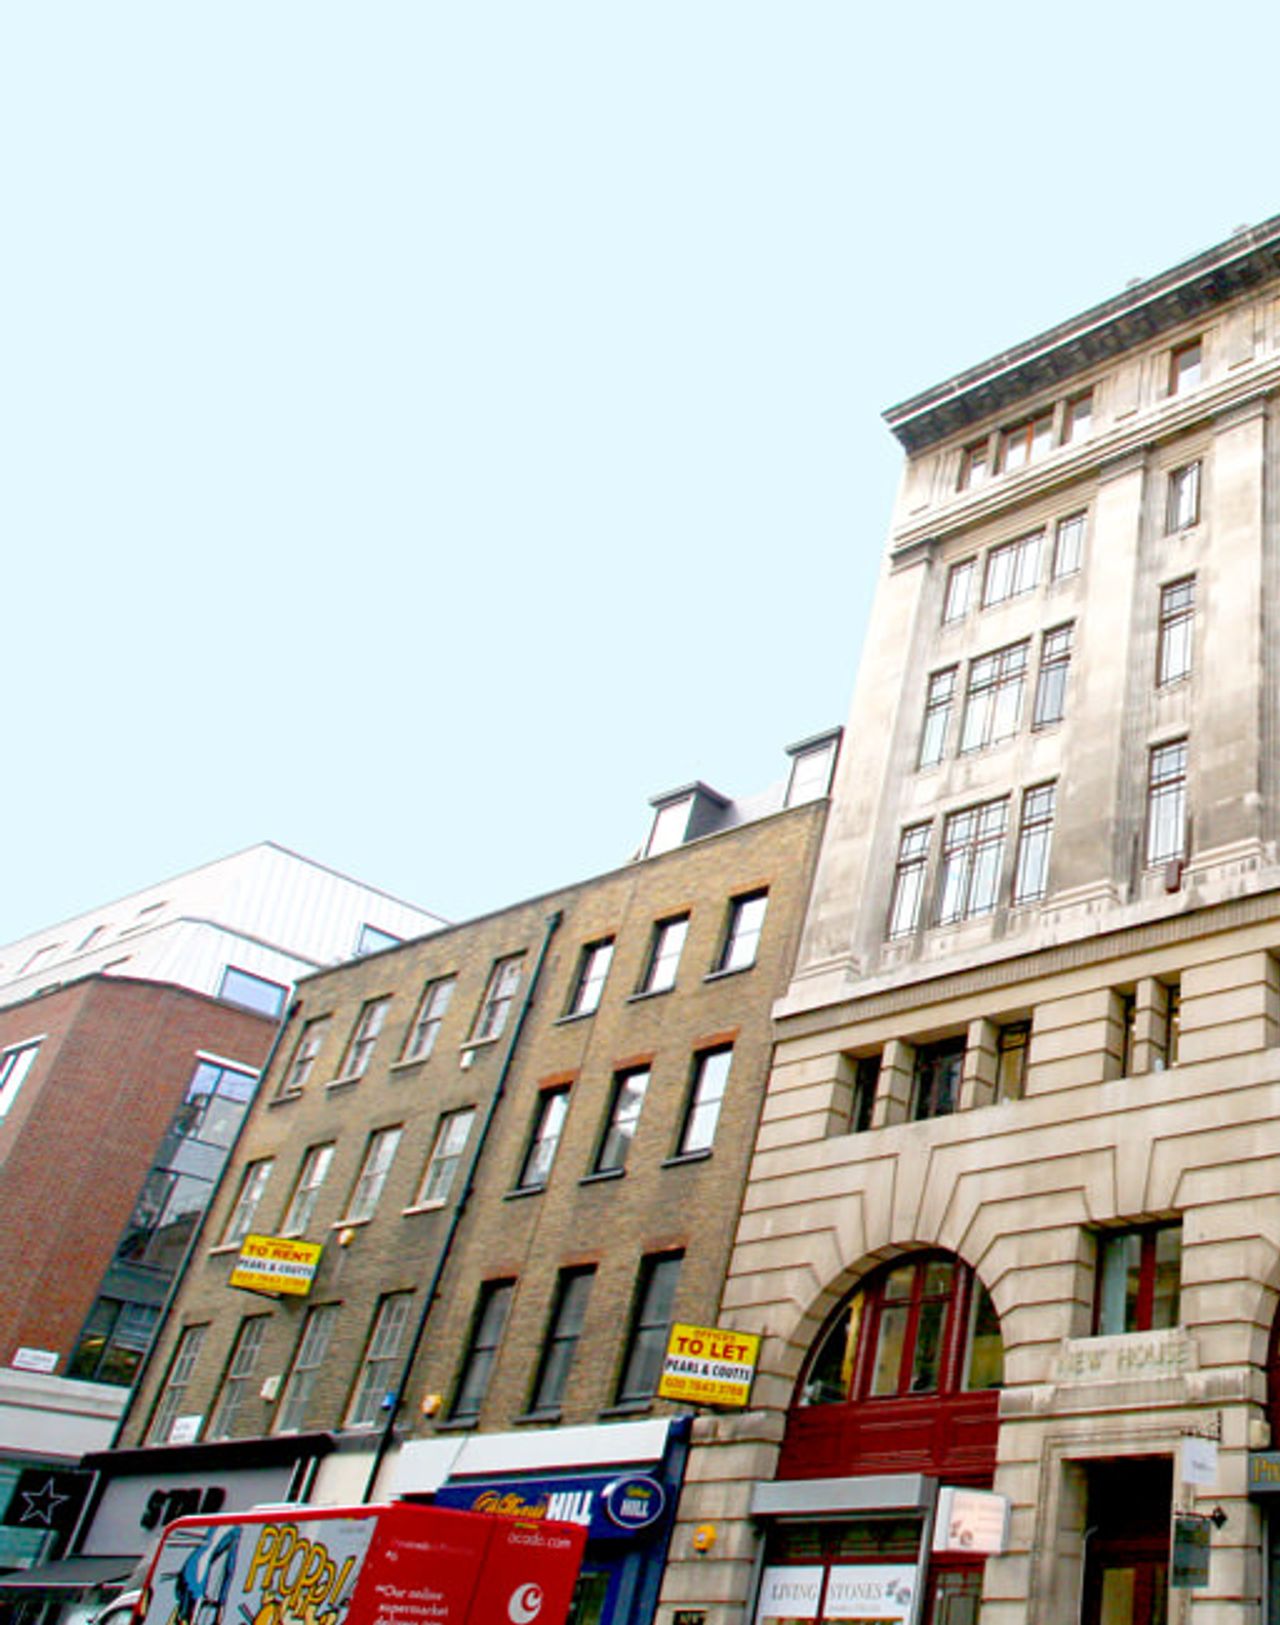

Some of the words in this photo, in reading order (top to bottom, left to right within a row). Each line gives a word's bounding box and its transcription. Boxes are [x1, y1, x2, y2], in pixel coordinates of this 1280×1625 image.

[249, 1243, 268, 1257] TO
[273, 1247, 314, 1263] RENT
[678, 1336, 704, 1356] TO
[709, 1342, 749, 1361] LET
[1056, 1348, 1107, 1376] NEW
[1116, 1341, 1190, 1371] HOUSE
[665, 1358, 700, 1374] PEARL
[712, 1364, 751, 1381] COUTTS
[545, 1490, 594, 1526] HILL
[619, 1498, 649, 1518] HILL
[507, 1532, 572, 1549] ocado.com
[407, 1585, 444, 1600] online
[772, 1583, 818, 1601] LIVING
[830, 1581, 882, 1599] STONES
[378, 1603, 450, 1617] supermarket
